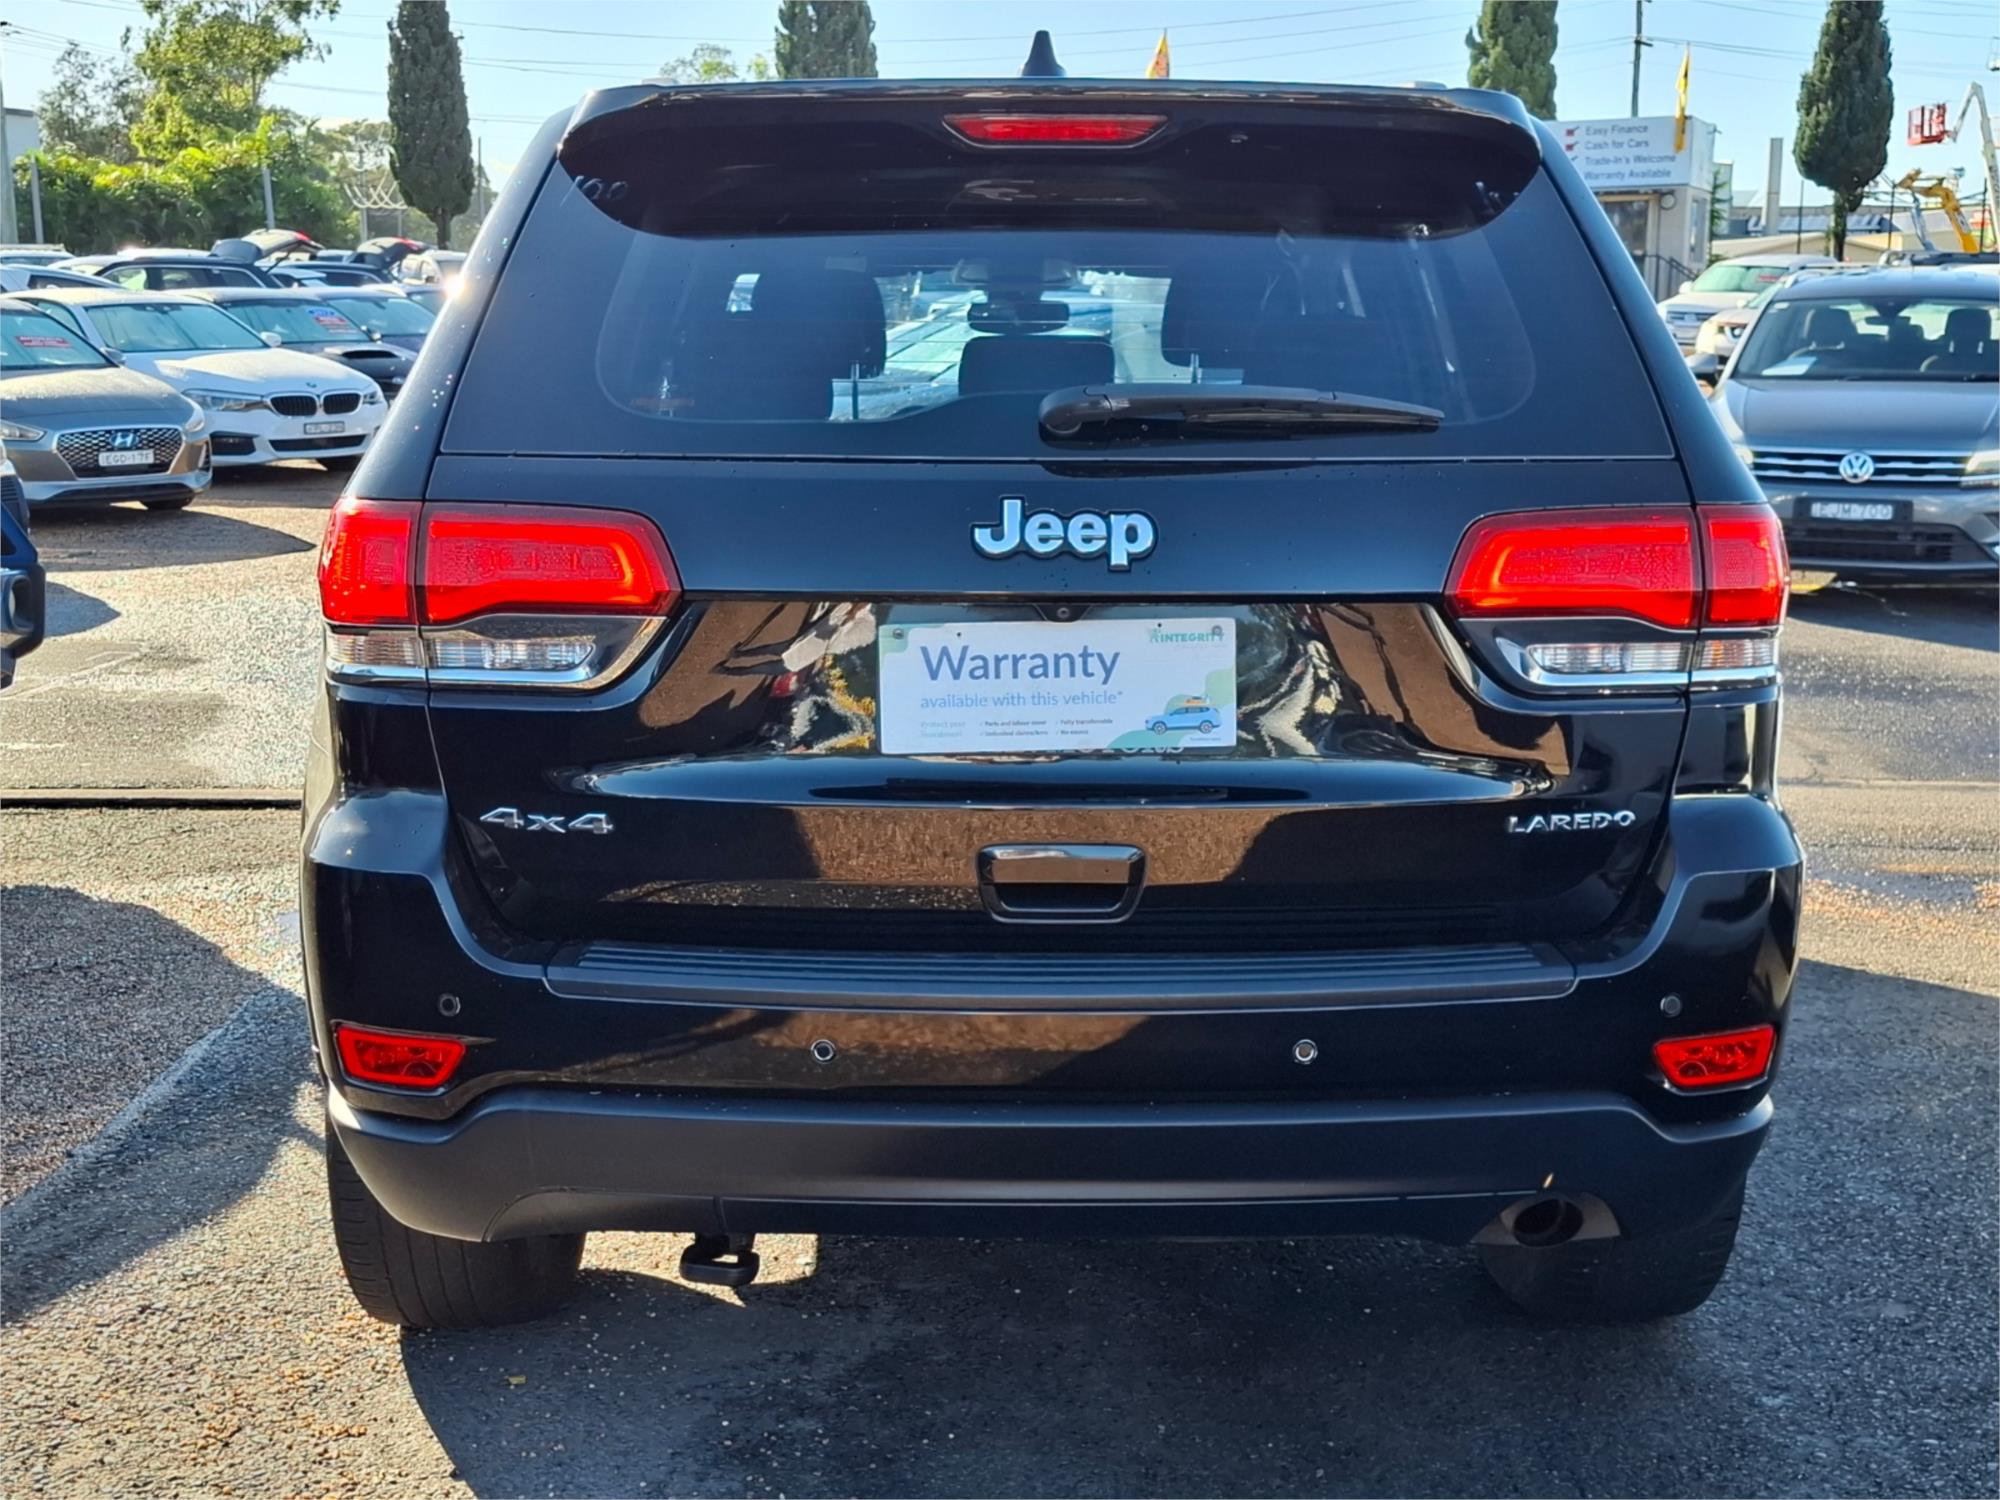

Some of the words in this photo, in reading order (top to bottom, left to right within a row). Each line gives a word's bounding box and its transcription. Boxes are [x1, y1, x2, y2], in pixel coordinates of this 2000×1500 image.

[1585, 126, 1608, 137] Easy
[1611, 125, 1648, 134] Finance
[1584, 140, 1608, 150] Cash
[1611, 140, 1624, 149] for
[1627, 139, 1649, 148] Cars
[1633, 155, 1676, 163] Welcome
[1584, 171, 1625, 181] Warranty
[1628, 169, 1671, 178] Available
[972, 498, 1155, 567] Jeep
[920, 645, 1120, 685] Warranty
[921, 693, 986, 708] available
[991, 692, 1026, 707] with
[1031, 691, 1058, 706] this
[480, 807, 613, 834] 4x4
[1508, 810, 1636, 833] LAREDO
